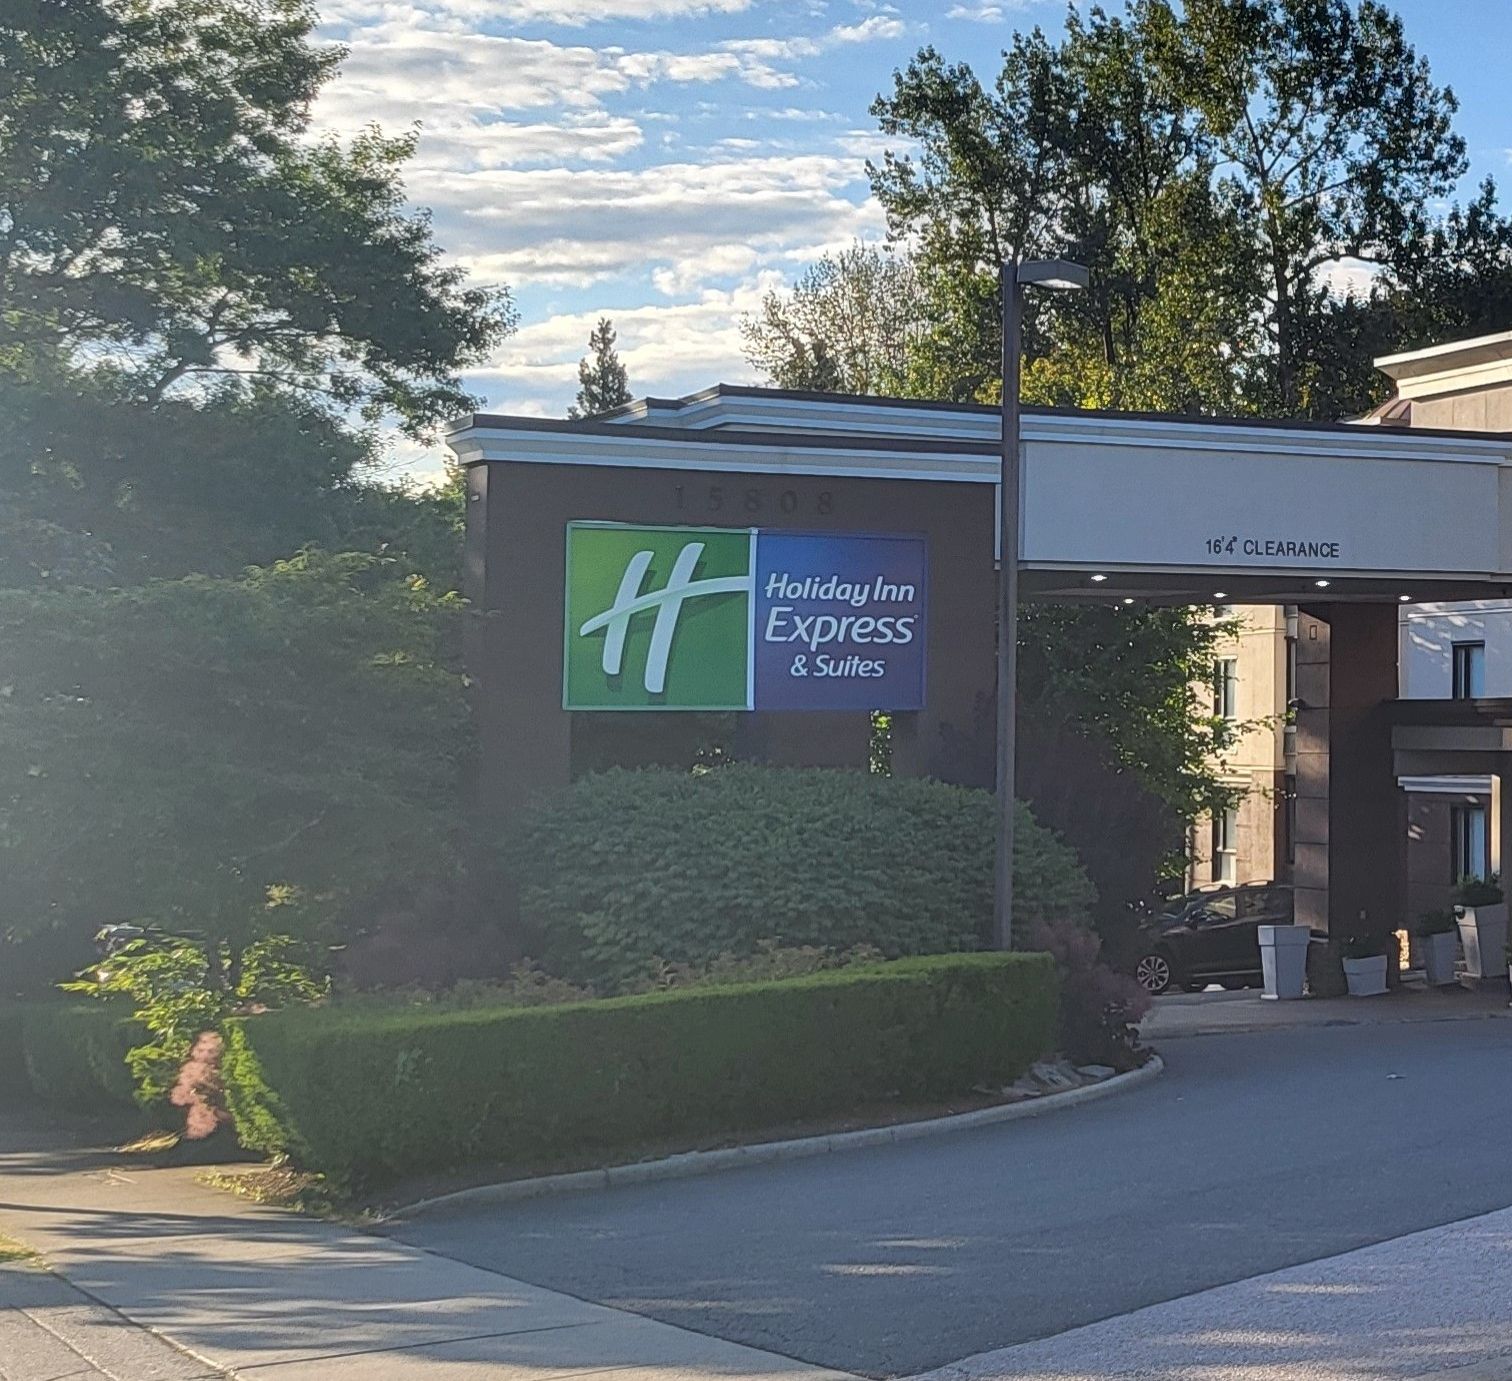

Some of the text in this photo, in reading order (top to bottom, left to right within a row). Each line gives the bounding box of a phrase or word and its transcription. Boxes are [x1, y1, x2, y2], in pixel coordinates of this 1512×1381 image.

[673, 485, 833, 515] 15808
[1243, 539, 1340, 558] CLEARANCE
[764, 573, 915, 607] Holiday Inn
[764, 606, 915, 652] Express
[790, 654, 886, 677] & Suites
